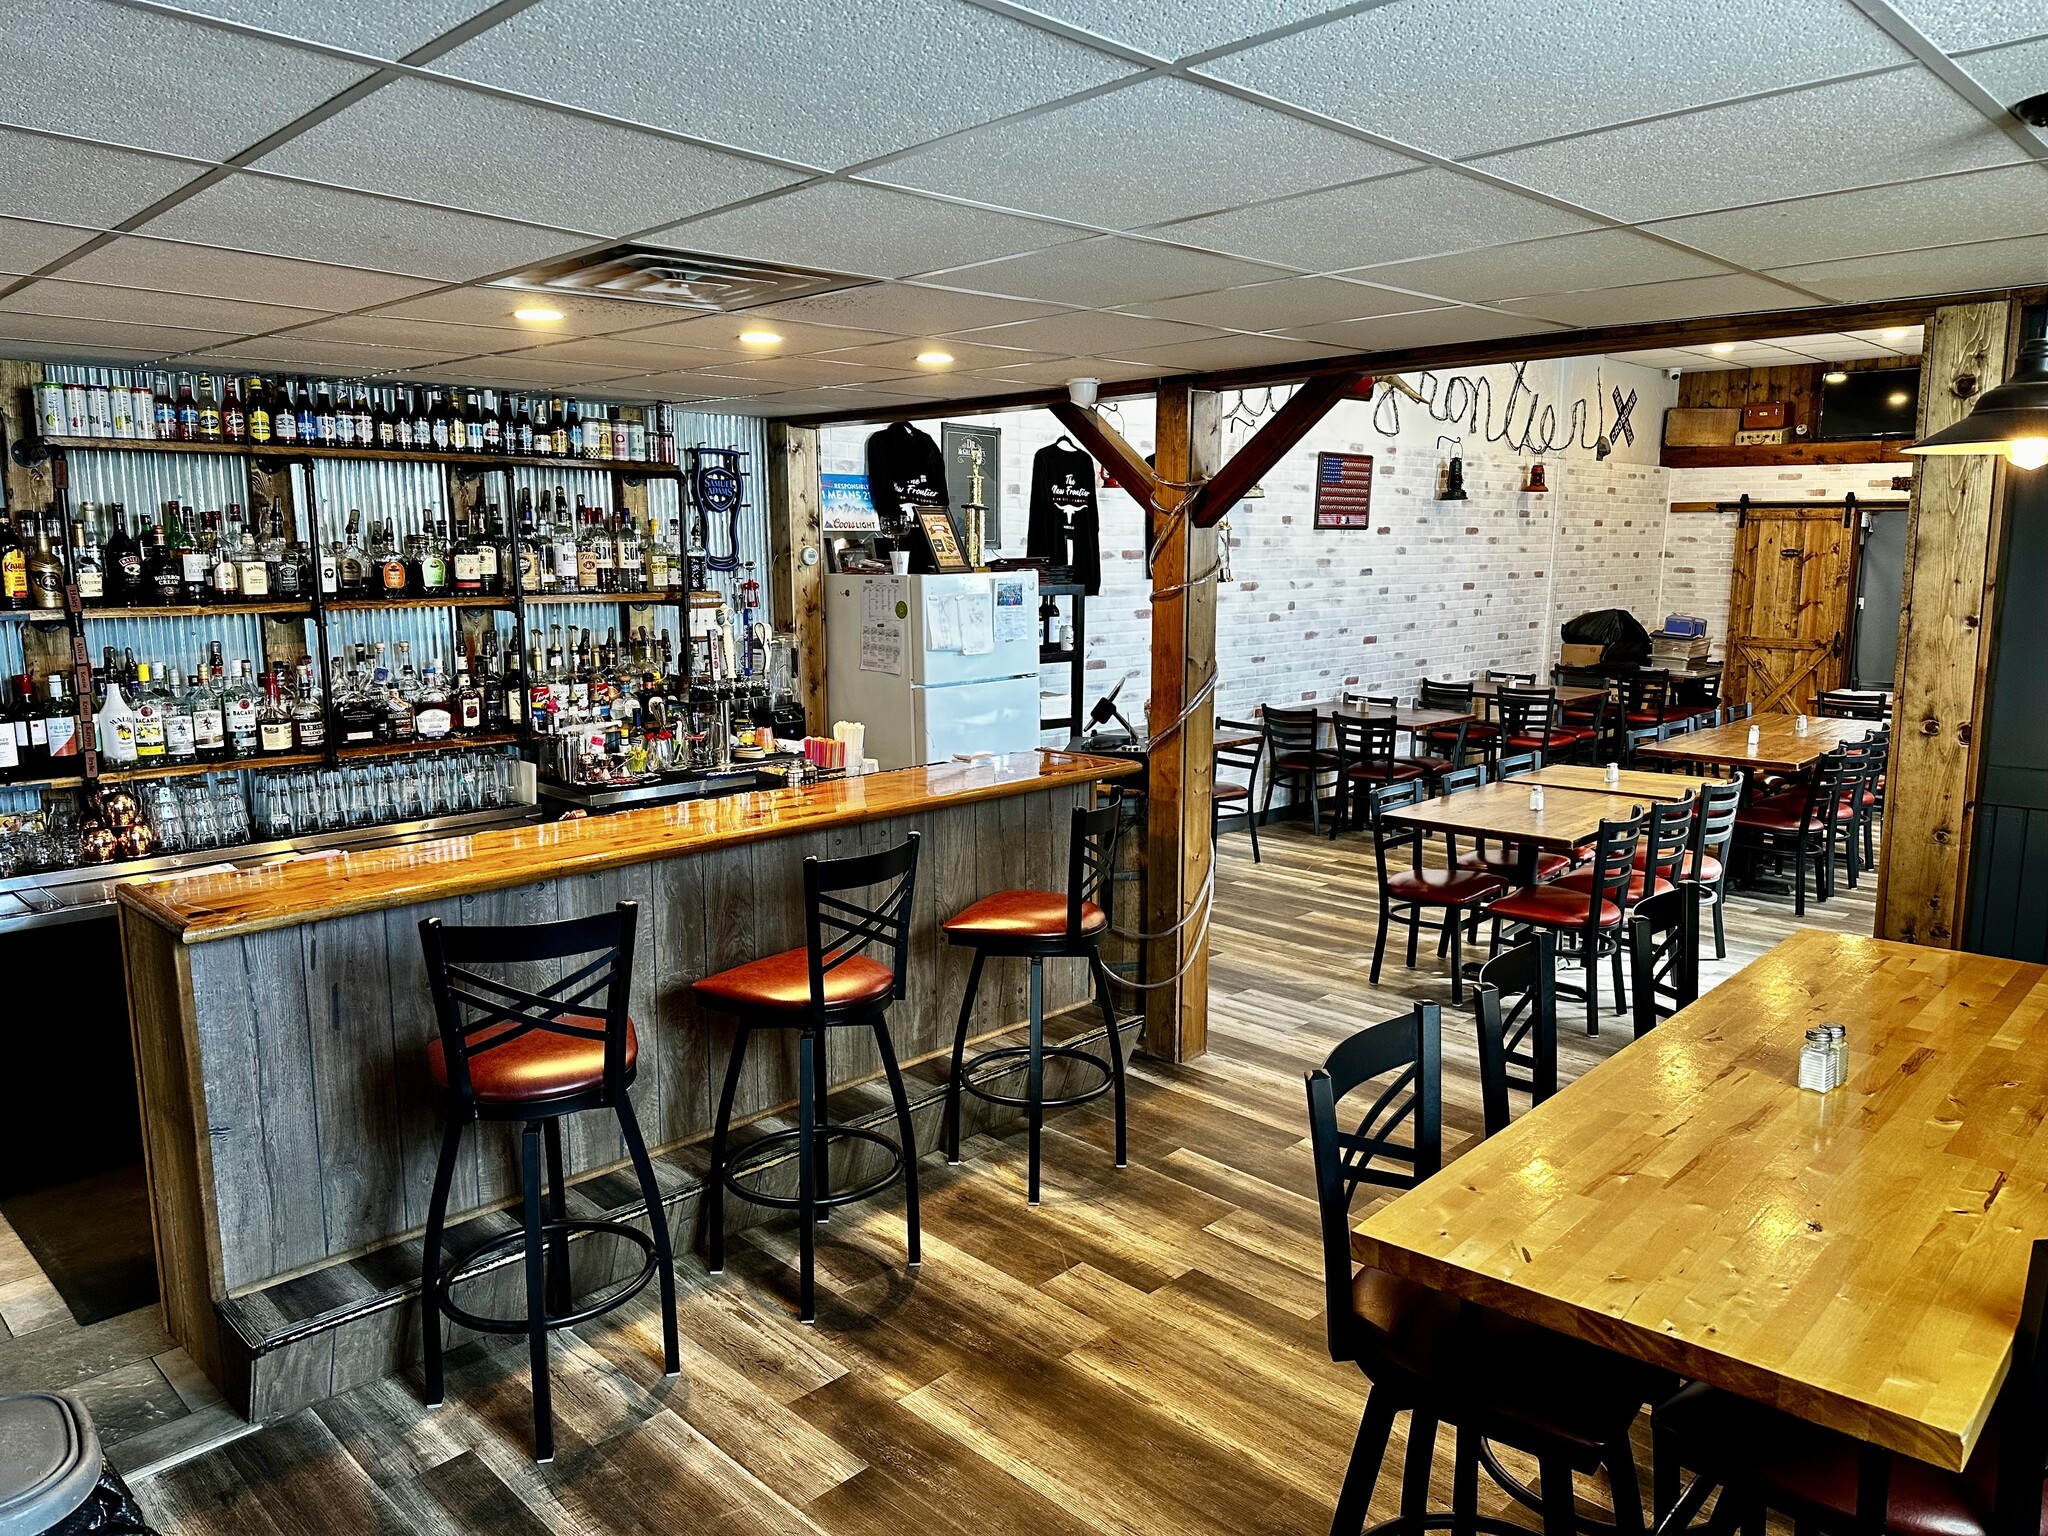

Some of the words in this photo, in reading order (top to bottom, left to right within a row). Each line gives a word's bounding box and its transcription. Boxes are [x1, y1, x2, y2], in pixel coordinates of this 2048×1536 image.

[1611, 393, 1636, 442] CROSSING
[704, 479, 735, 489] SAMUEL
[1065, 474, 1076, 485] The
[707, 487, 733, 496] ADAMS
[828, 490, 861, 500] MEANS
[862, 491, 872, 500] 21
[907, 484, 939, 497] Frontier
[1051, 484, 1065, 495] New
[1066, 485, 1091, 497] Frontier
[833, 518, 857, 529] Coors
[856, 521, 876, 529] LIGHT
[44, 578, 57, 587] 43
[69, 589, 79, 609] Haley
